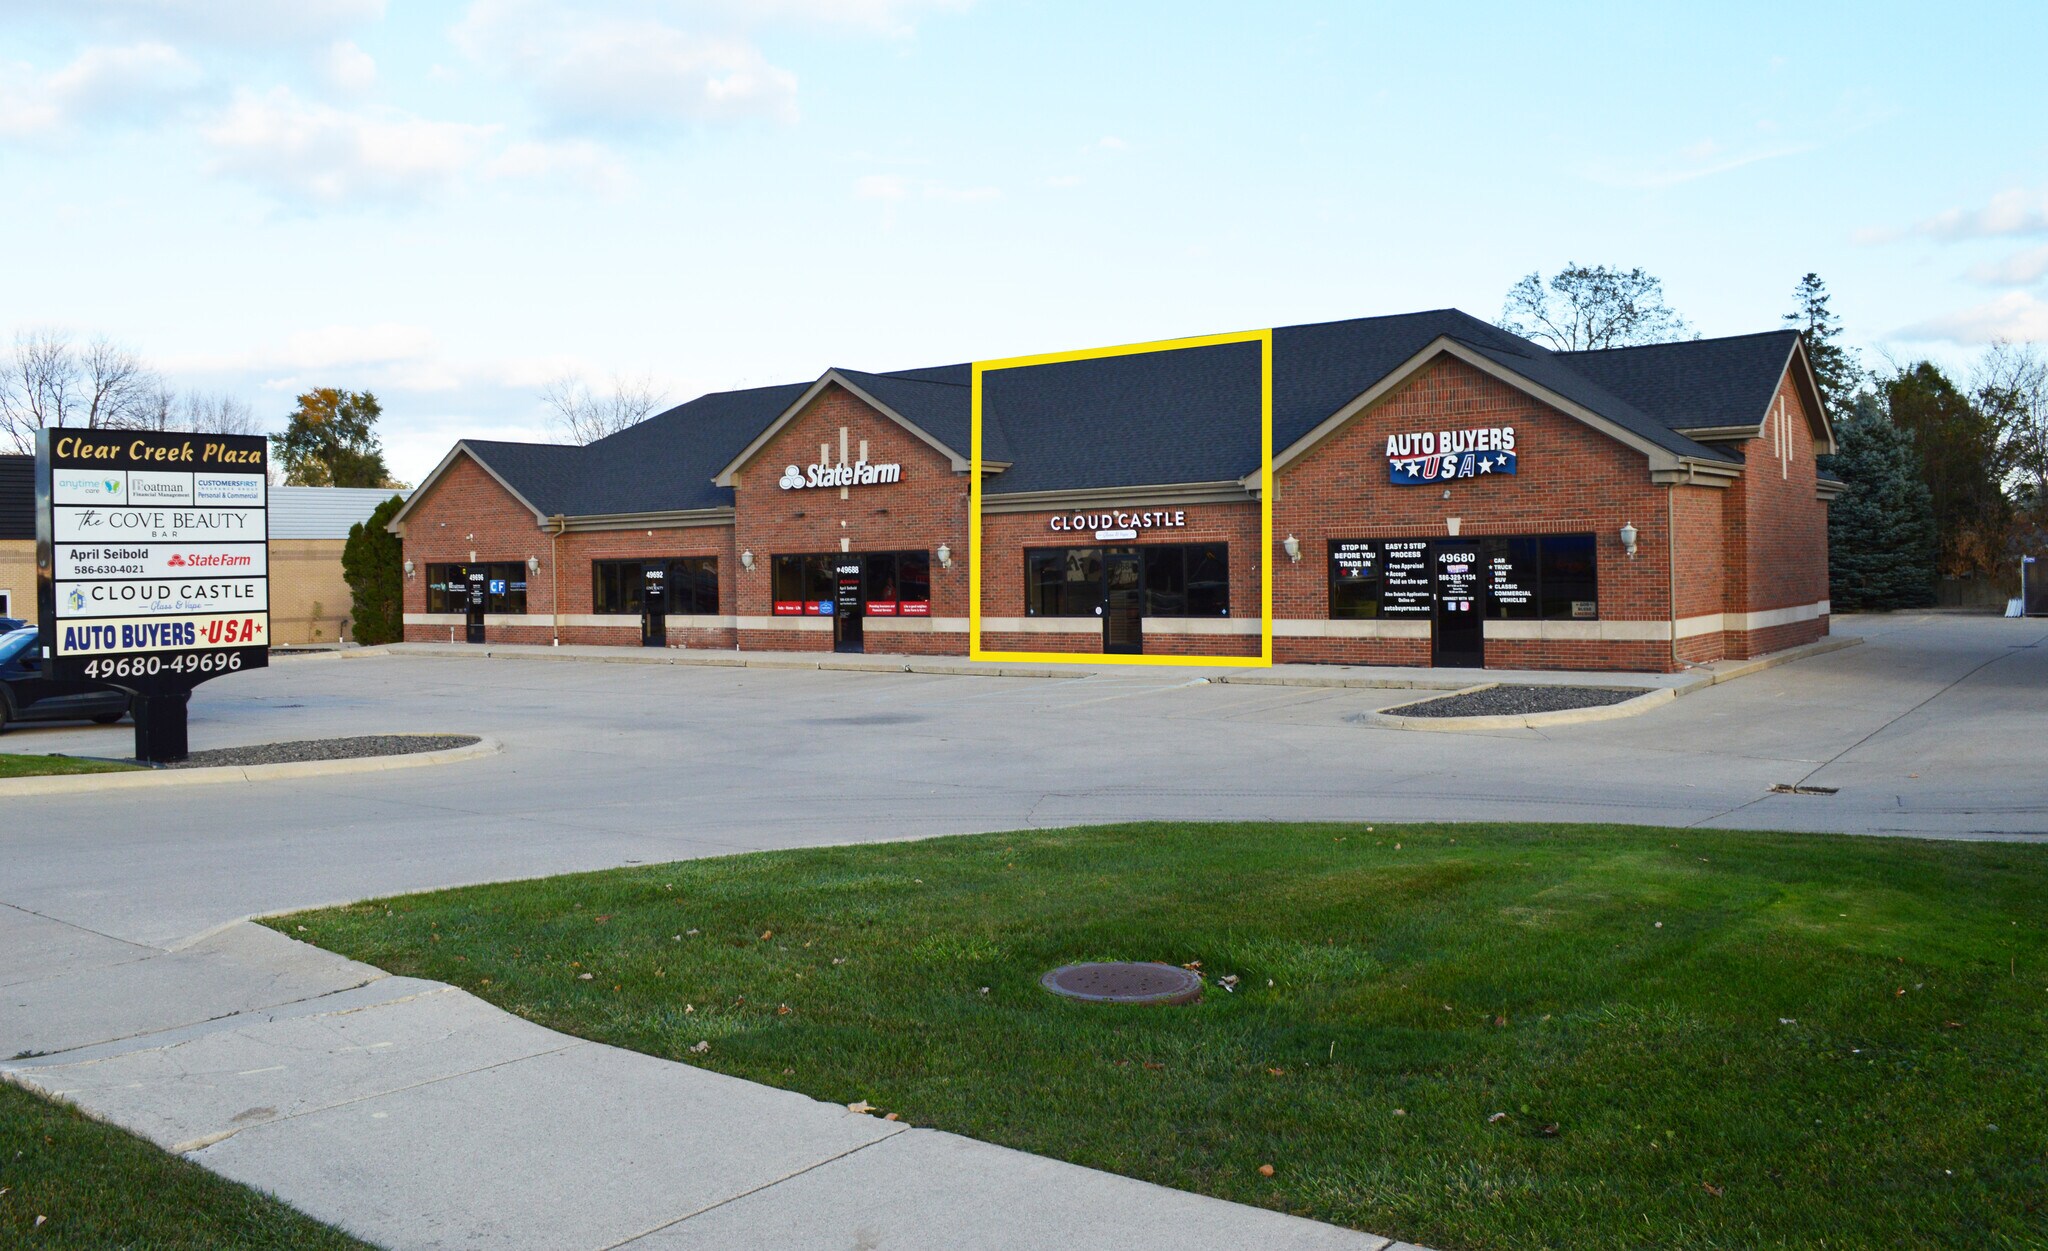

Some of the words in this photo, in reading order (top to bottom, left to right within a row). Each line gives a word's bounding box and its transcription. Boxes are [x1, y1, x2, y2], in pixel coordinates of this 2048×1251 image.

[56, 437, 120, 459] Clear
[129, 440, 194, 462] Creek
[202, 443, 262, 464] Plaza
[1386, 432, 1435, 456] AUTO
[1440, 427, 1515, 453] BUYERS
[1422, 454, 1476, 480] USA
[58, 479, 100, 490] anytime
[74, 510, 104, 530] the
[109, 512, 164, 528] COVE
[173, 512, 248, 529] BEAUTY
[1050, 514, 1113, 530] CLOUD
[1118, 511, 1185, 528] CASTLE
[70, 548, 99, 562] April
[104, 548, 149, 559] Seibold
[1439, 553, 1475, 562] 49680
[74, 565, 144, 574] 586-630-4021
[92, 585, 171, 600] CLOUD
[180, 584, 254, 599] CASTLE
[150, 602, 172, 611] Glass
[176, 601, 183, 610] &
[185, 601, 201, 610] Vape
[64, 625, 116, 651] AUTO
[122, 622, 195, 649] BUYERS
[207, 618, 254, 644] USA
[84, 652, 242, 679] 49680-49696
